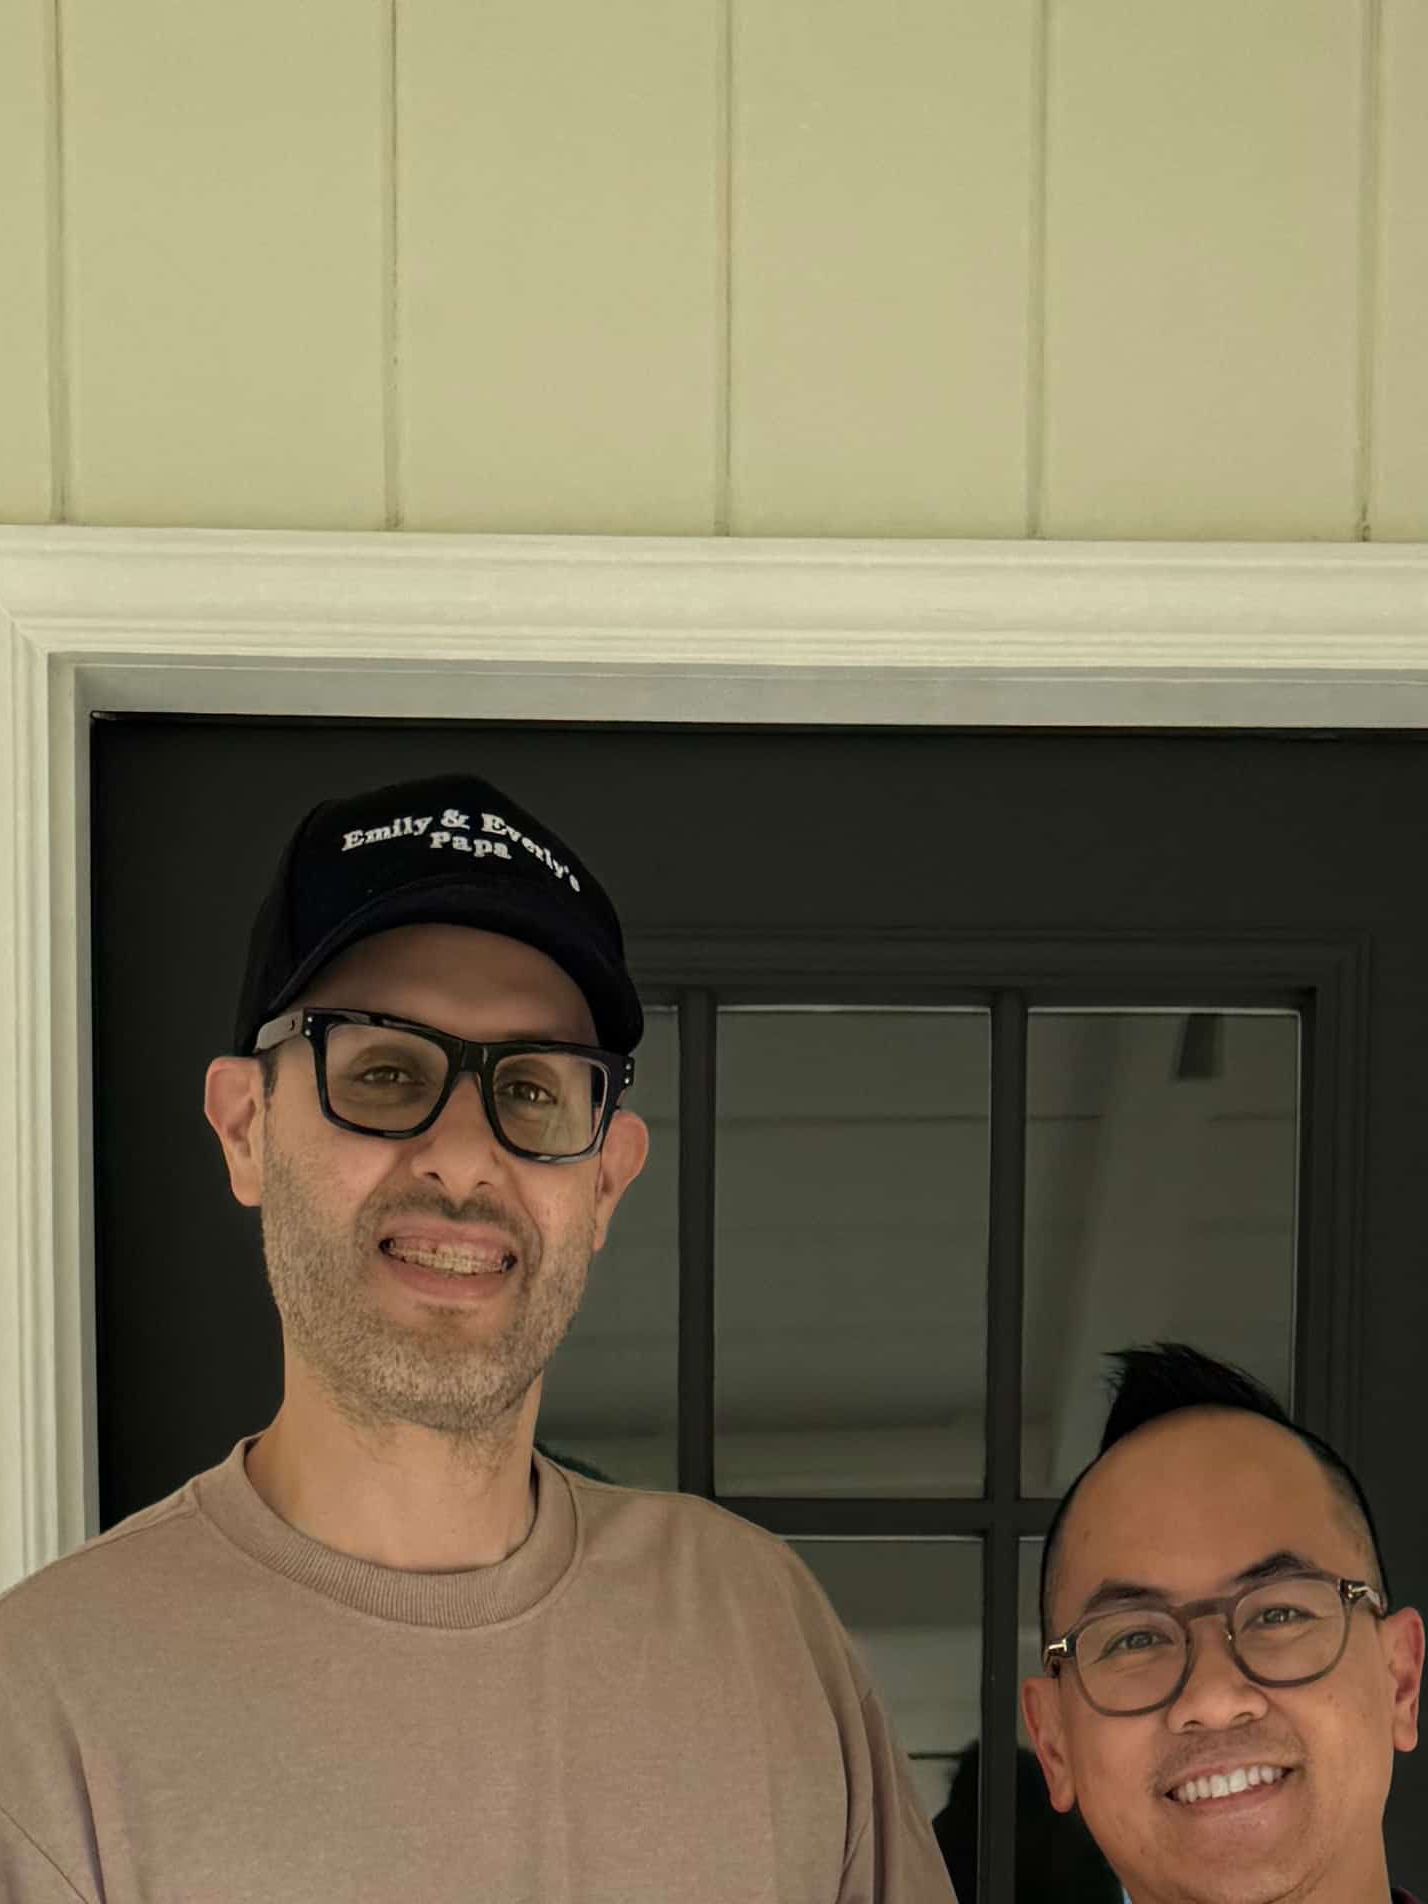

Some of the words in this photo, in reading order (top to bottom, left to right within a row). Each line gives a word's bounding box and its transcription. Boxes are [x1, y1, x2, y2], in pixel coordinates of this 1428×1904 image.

[340, 816, 433, 852] Emily
[440, 808, 471, 830] &
[429, 830, 513, 860] Papa
